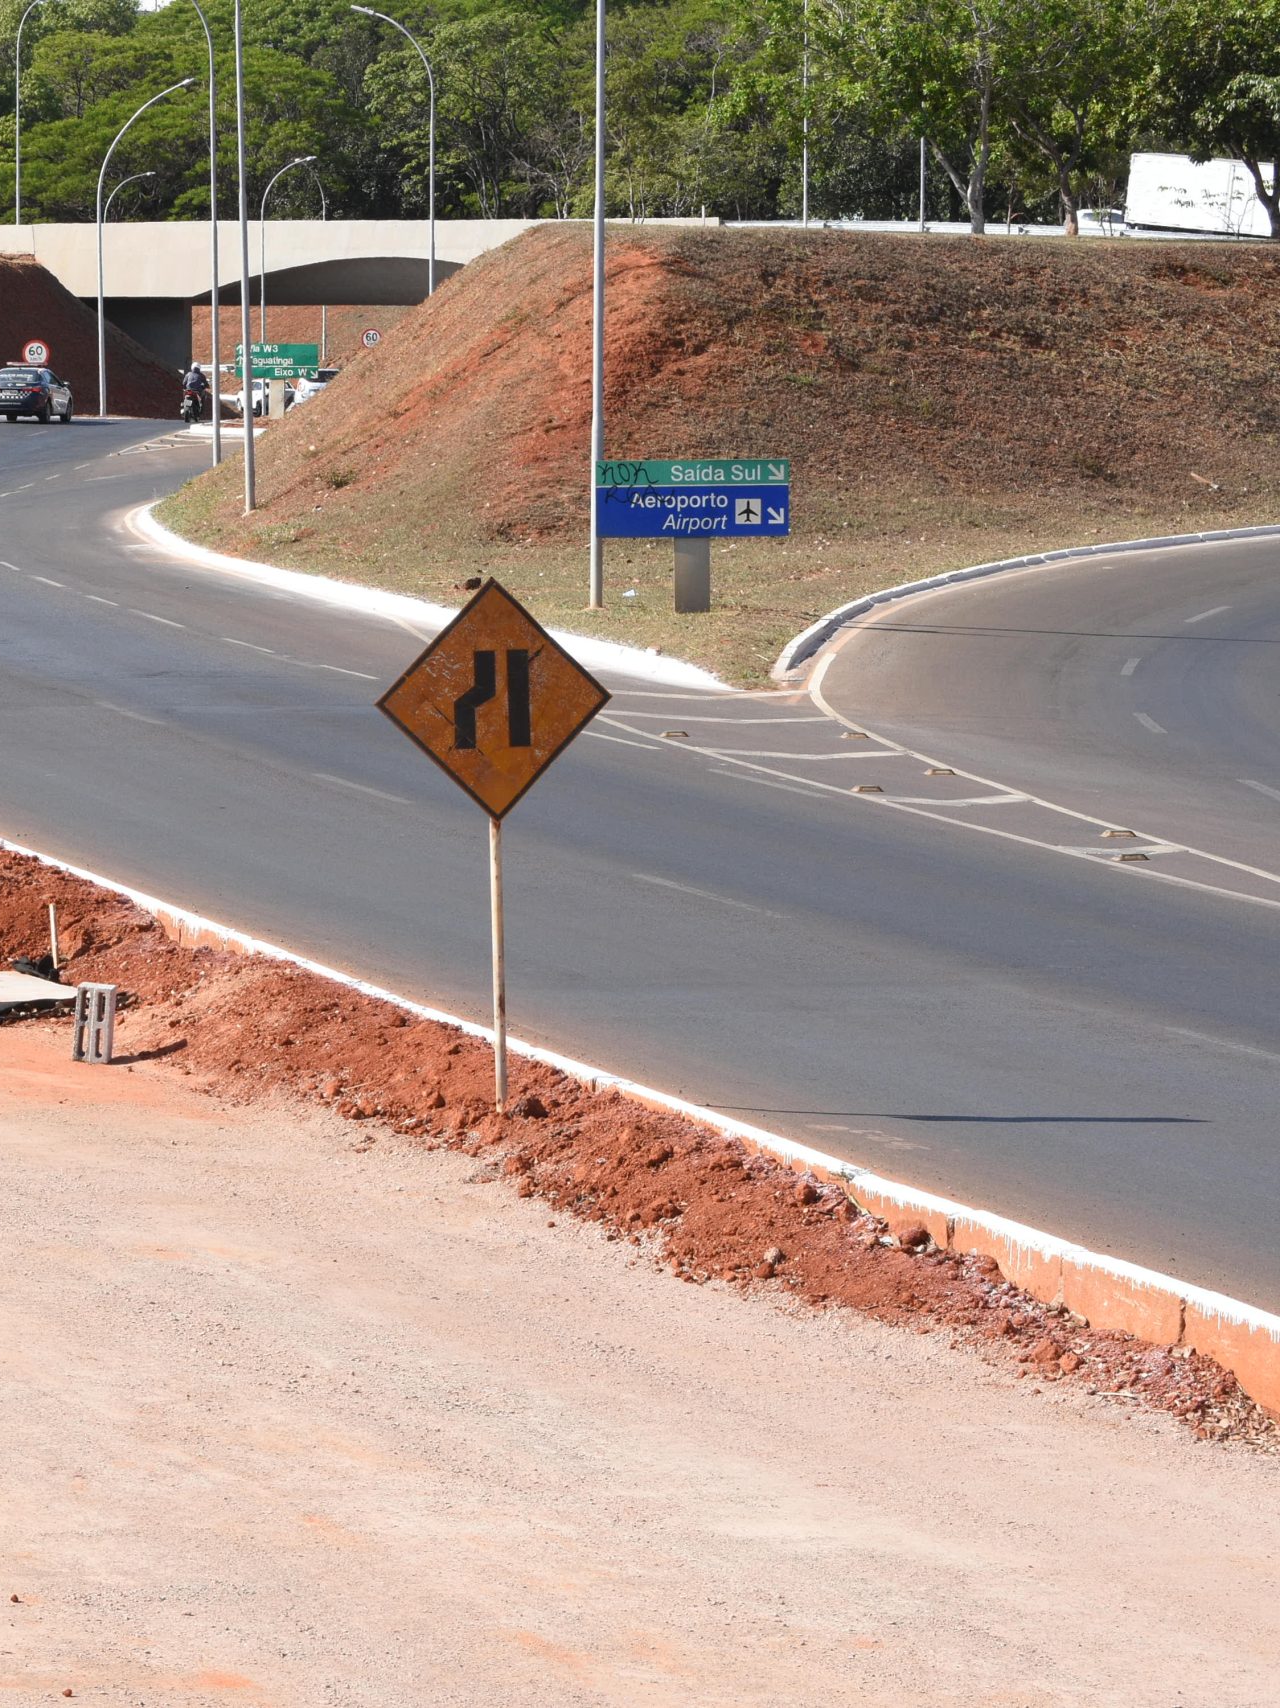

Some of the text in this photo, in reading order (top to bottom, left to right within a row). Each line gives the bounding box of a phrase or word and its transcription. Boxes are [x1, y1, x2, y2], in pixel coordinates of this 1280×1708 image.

[366, 333, 377, 341] 60
[29, 346, 43, 356] 60
[263, 345, 278, 353] W3
[250, 356, 294, 367] aguatinga
[274, 368, 308, 377] Eixo W
[670, 464, 762, 482] Saída Sul
[630, 493, 728, 512] Aeroporto
[662, 513, 728, 534] Airport
